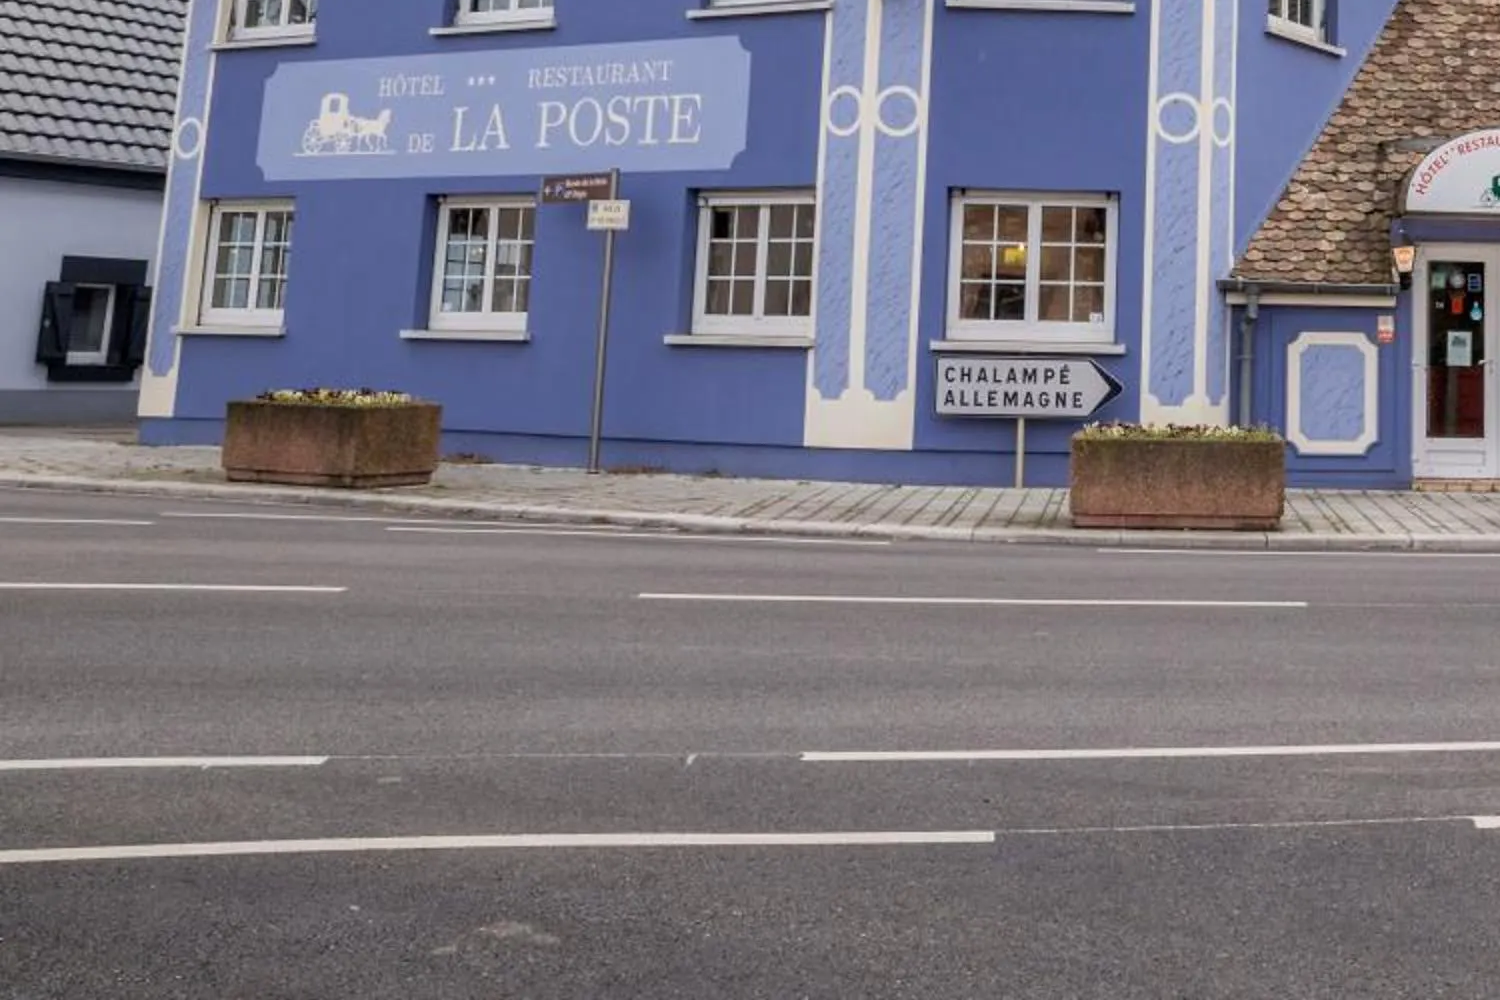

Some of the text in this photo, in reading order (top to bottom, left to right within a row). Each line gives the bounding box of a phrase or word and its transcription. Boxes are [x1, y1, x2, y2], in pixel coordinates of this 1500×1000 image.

[378, 60, 673, 98] HÔTEL RESTAURANT
[407, 94, 702, 154] DE LA POSTE
[1415, 152, 1449, 196] HÔTEL
[944, 364, 1070, 384] CHALAMPÉ
[944, 390, 1083, 409] ALLEMAGNE
